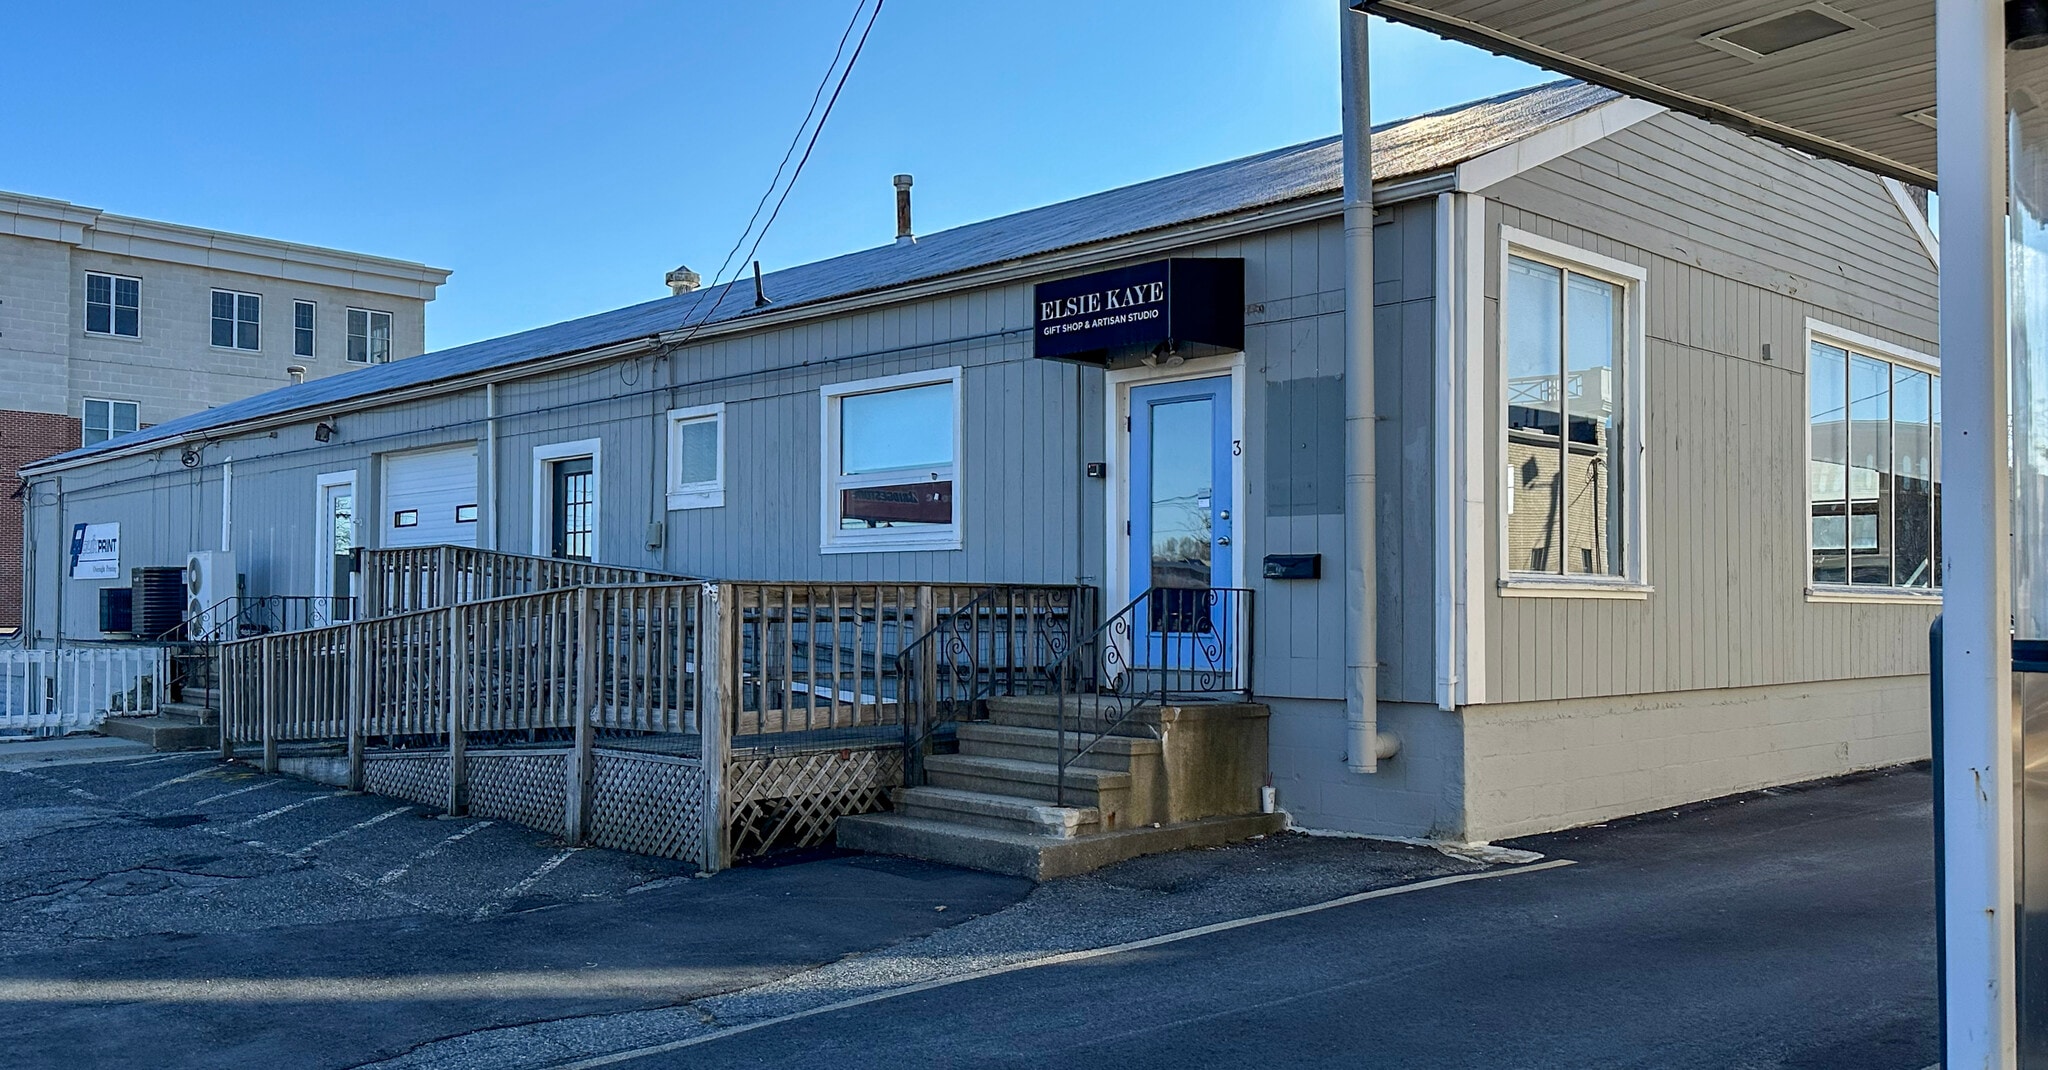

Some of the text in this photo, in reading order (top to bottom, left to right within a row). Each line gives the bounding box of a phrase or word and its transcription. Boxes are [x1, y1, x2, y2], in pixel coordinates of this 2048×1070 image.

[1040, 281, 1164, 321] ELSIE KAYE
[1043, 309, 1159, 336] GIFT SHOP & ARTISAN STUDIO
[1233, 440, 1242, 456] 3
